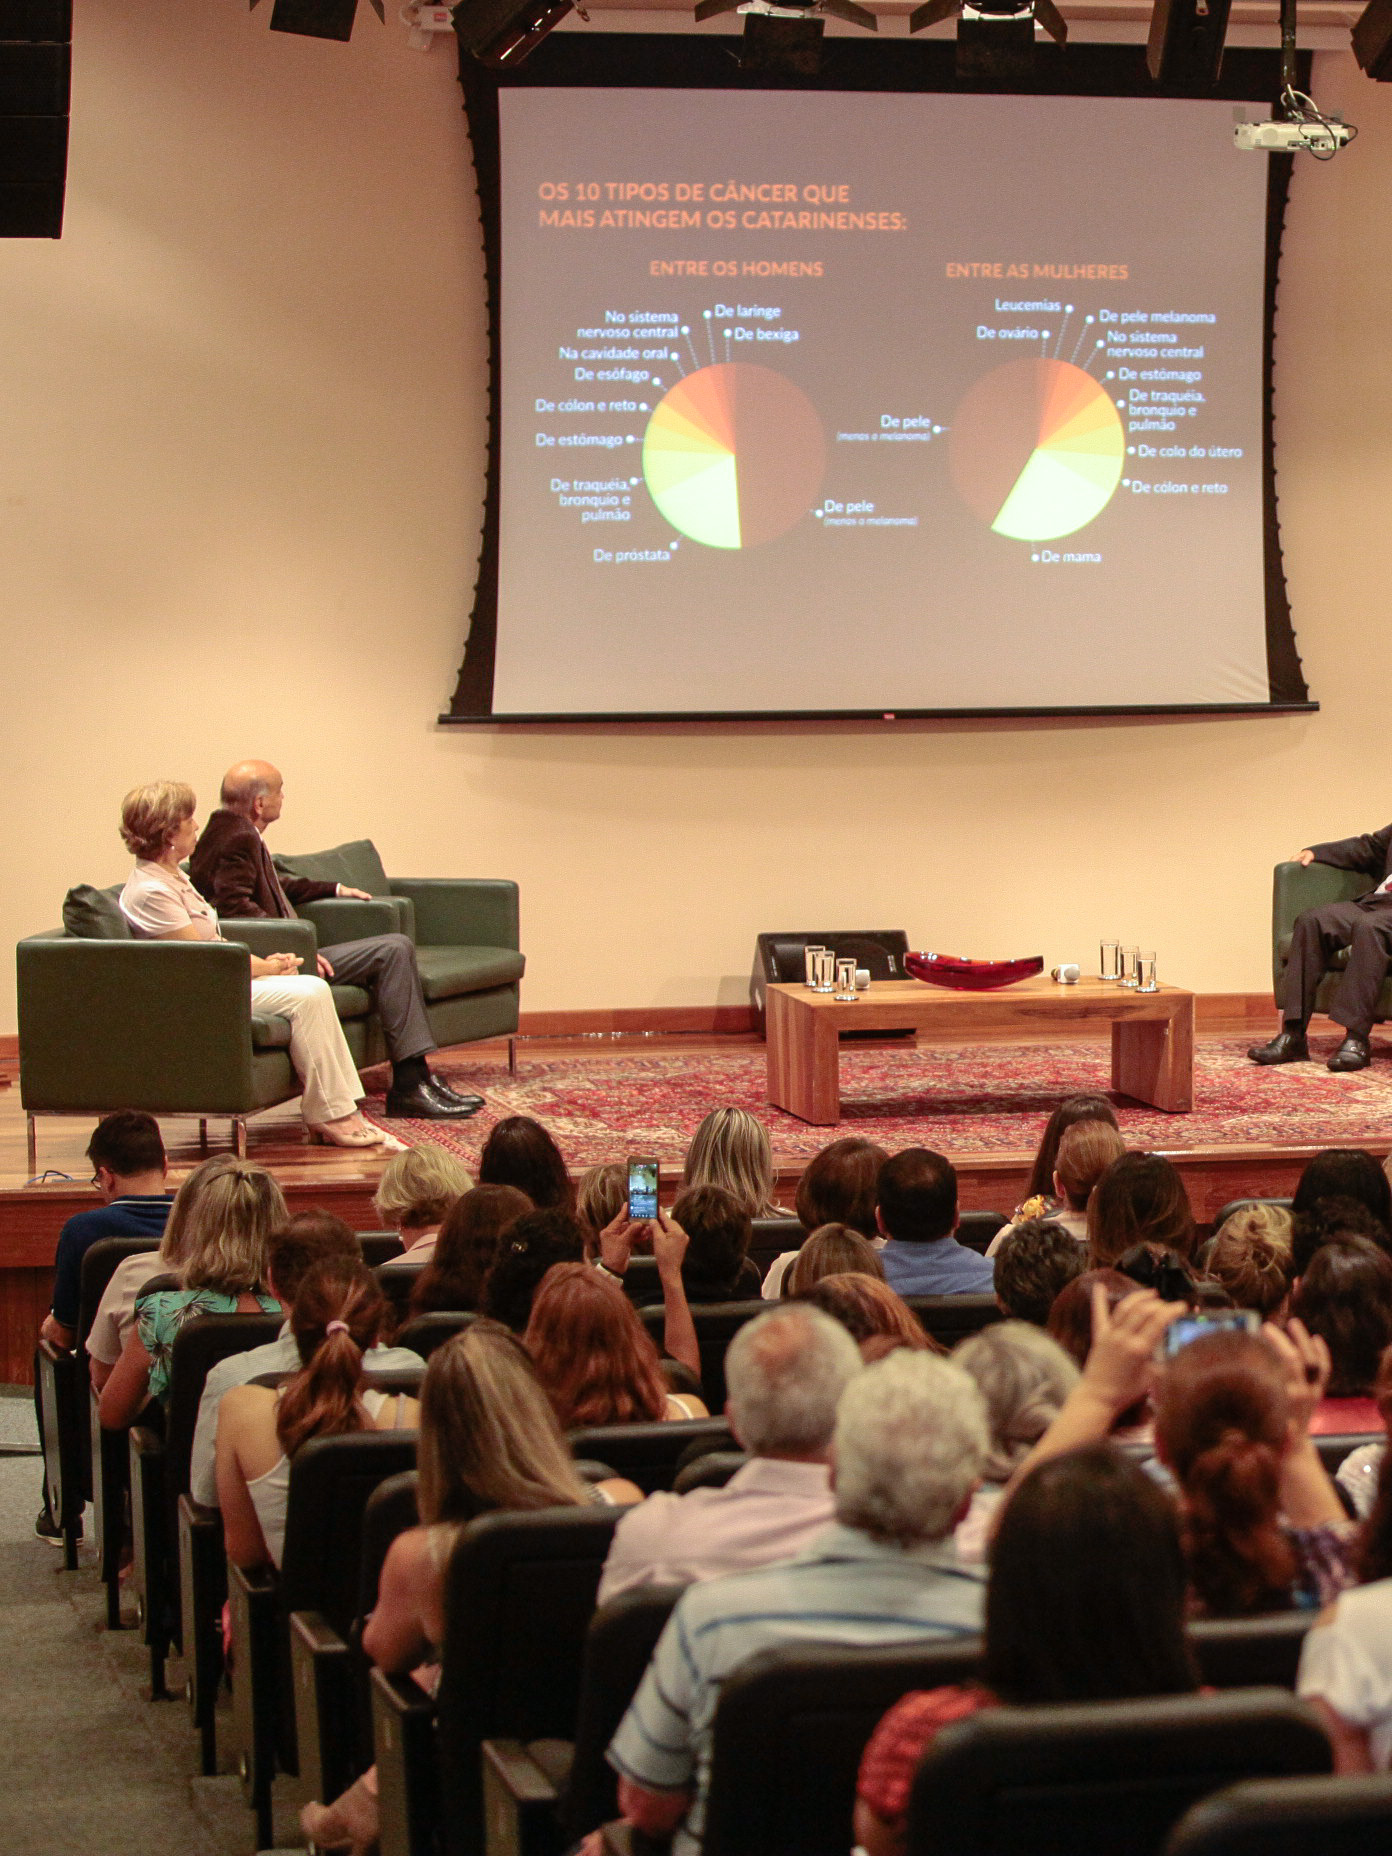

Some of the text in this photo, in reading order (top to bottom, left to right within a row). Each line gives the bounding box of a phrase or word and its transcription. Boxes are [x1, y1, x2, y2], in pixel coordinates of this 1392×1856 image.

[539, 180, 850, 205] OS 10 TIPOS DE CÂNCER QUE
[539, 209, 907, 230] MAIS ATINGEM OS CATARINENSES:
[650, 260, 824, 277] ENTRE OS HOMENS
[946, 263, 1129, 280] ENTRE AS MULHERES
[714, 304, 781, 320] De laringe
[995, 299, 1061, 312] Leucemias
[605, 311, 678, 324] No sistema
[1099, 310, 1216, 325] De pele melanoma
[577, 325, 678, 339] nervoso central
[734, 328, 799, 345] De bexiga
[976, 326, 1039, 340] De ovário
[1107, 331, 1178, 345] No sistema
[559, 347, 669, 361] Na cavidade oral
[1107, 346, 1204, 359] nervoso central
[574, 367, 594, 381] De
[1119, 367, 1202, 384] De estômago
[1129, 388, 1147, 402] De
[535, 399, 637, 412] De cólon e reto
[1187, 406, 1197, 416] e
[881, 416, 931, 431] De pele
[1129, 417, 1175, 432] pulmão
[536, 433, 555, 446] De
[1138, 445, 1242, 459] De colo do útero
[551, 478, 570, 492] De
[1132, 480, 1228, 494] De cólon e reto
[622, 496, 631, 506] e
[824, 500, 874, 515] De pele
[581, 508, 631, 524] pulmão
[593, 548, 671, 564] De próstata
[1041, 551, 1101, 563] De mama
